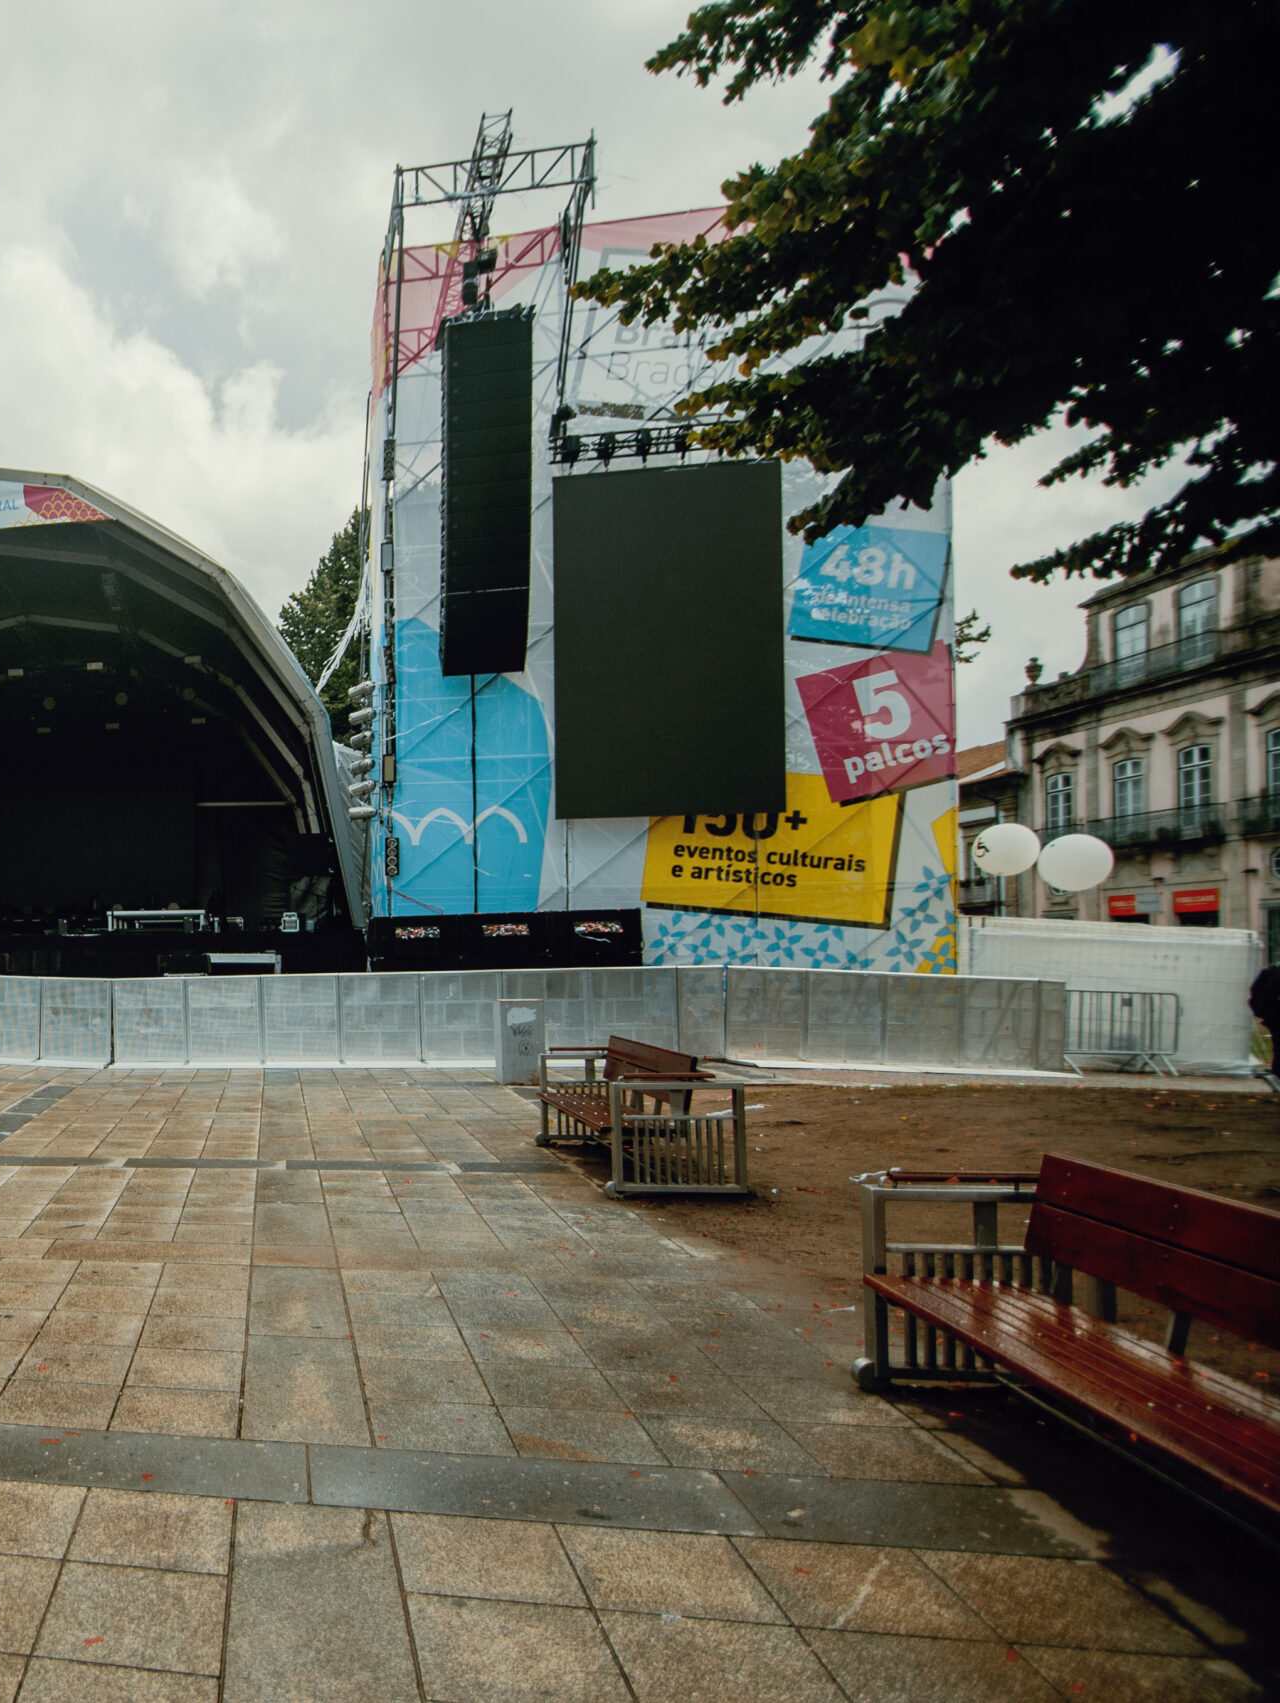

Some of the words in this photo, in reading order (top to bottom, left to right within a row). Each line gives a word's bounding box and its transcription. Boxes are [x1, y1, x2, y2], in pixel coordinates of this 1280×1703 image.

[819, 544, 916, 591] 48h
[810, 607, 913, 631] celebração
[852, 669, 912, 739] 5
[843, 733, 951, 784] palcos
[671, 864, 684, 878] e
[690, 863, 797, 888] artísticos
[673, 844, 758, 864] eventos
[766, 849, 866, 873] culturais
